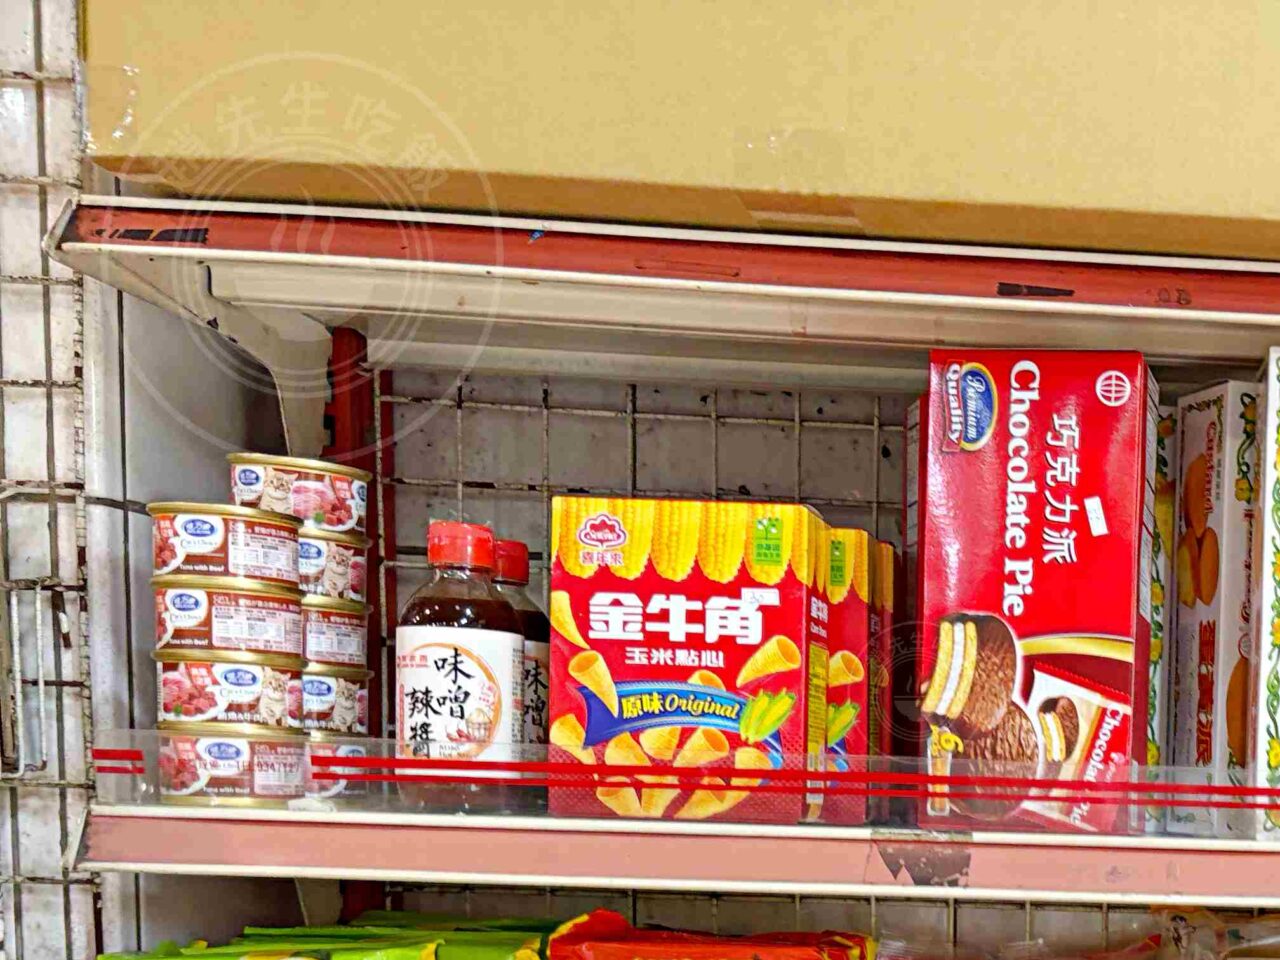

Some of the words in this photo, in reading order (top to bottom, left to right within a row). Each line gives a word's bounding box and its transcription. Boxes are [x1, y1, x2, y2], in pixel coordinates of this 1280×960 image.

[945, 362, 962, 446] Quality
[963, 371, 987, 440] Premium
[1004, 360, 1041, 549] Chocolate
[1042, 413, 1081, 565] 巧克力派
[588, 590, 764, 645] 金牛角
[1002, 557, 1036, 617] Pie
[433, 647, 475, 721] 味噌
[625, 646, 725, 668] 玉米點心
[404, 687, 442, 758] 辣醬
[621, 691, 663, 719] 原味
[664, 694, 740, 720] Original
